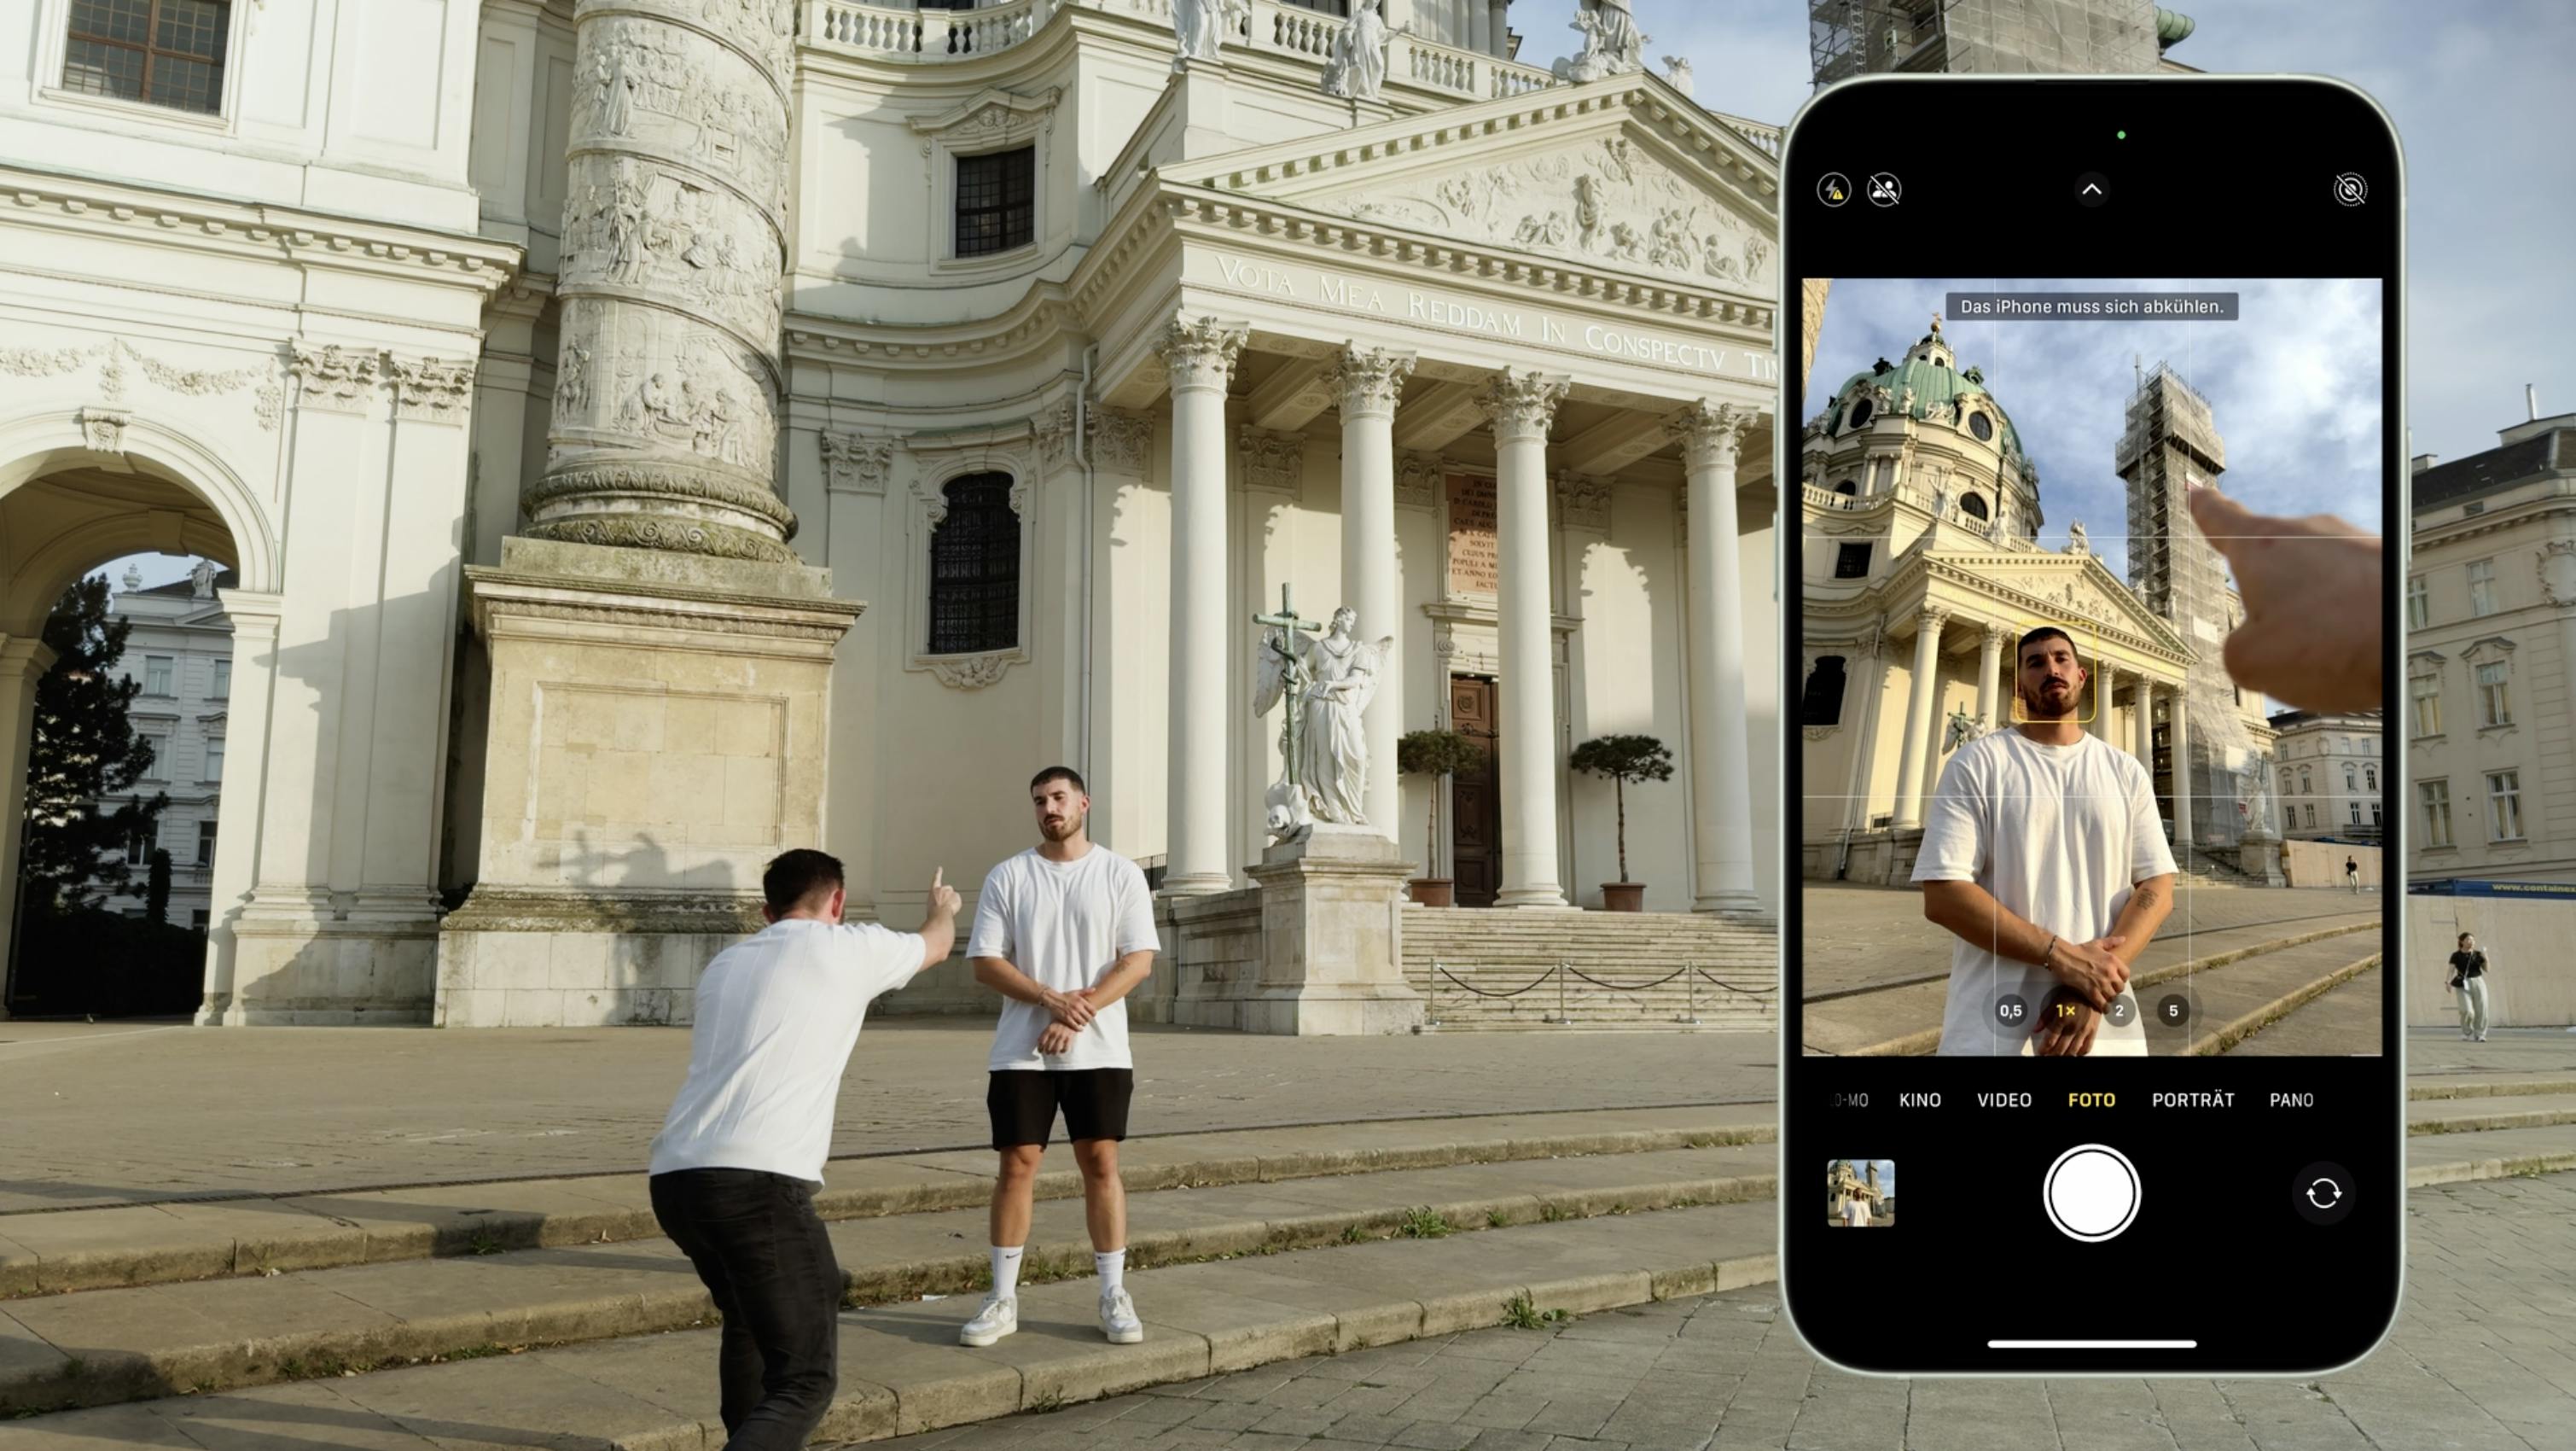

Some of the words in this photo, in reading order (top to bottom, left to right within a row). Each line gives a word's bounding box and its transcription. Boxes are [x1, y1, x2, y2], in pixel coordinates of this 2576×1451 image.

[1962, 300, 1991, 313] Das
[1996, 299, 2052, 313] iPhone
[2057, 302, 2100, 313] muss
[2105, 300, 2138, 313] sich
[2143, 299, 2224, 313] abkühlen.
[2000, 1005, 2022, 1019] 0,5
[2115, 1005, 2124, 1017] 2
[2169, 1005, 2179, 1017] 5
[1899, 1093, 1941, 1108] KINO
[1978, 1093, 2032, 1108] VIDEO
[2068, 1093, 2116, 1108] FOTO
[2153, 1089, 2236, 1108] PORTRÄT
[2271, 1093, 2314, 1108] PANO
